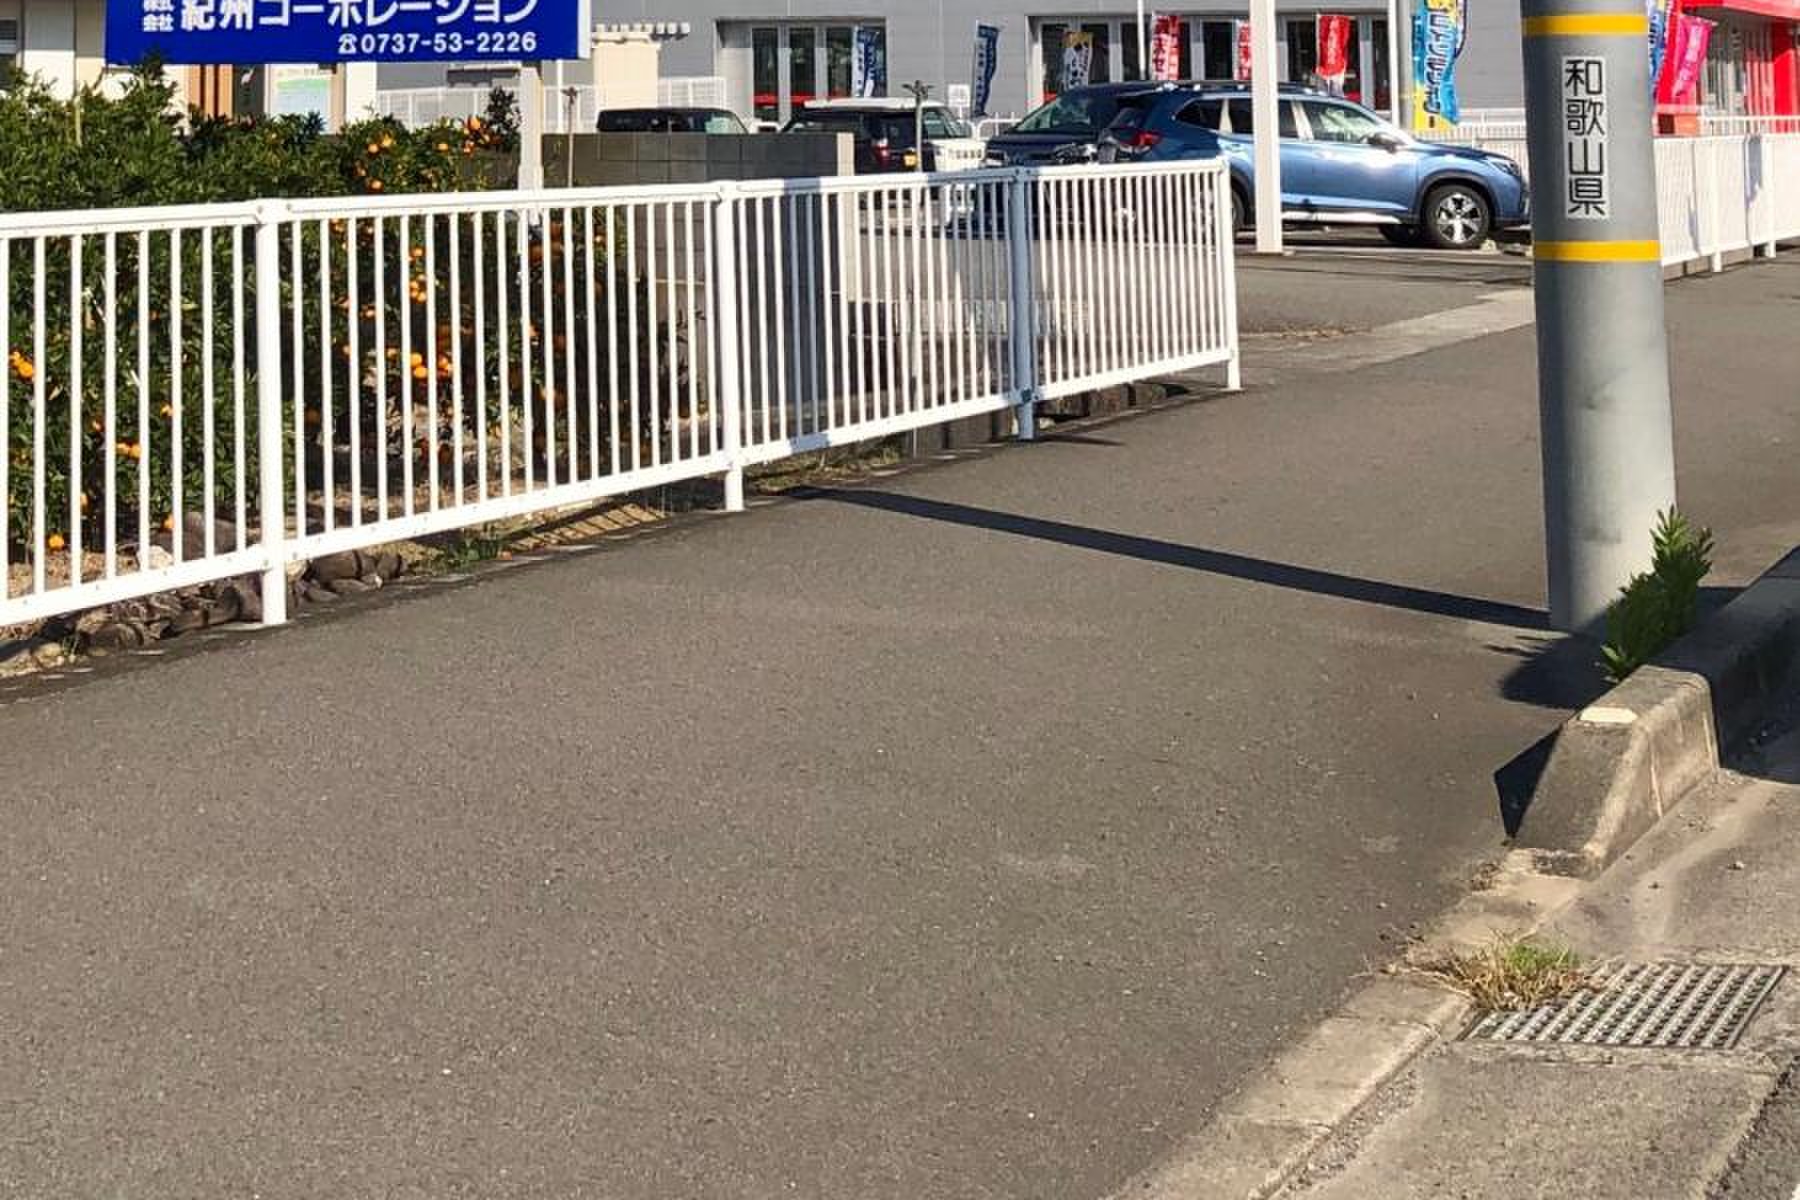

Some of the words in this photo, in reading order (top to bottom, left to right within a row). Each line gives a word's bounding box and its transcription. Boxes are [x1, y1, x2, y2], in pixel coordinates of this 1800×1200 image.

[360, 31, 538, 54] 0737-53-2226
[1564, 58, 1606, 216] 和歌山県
